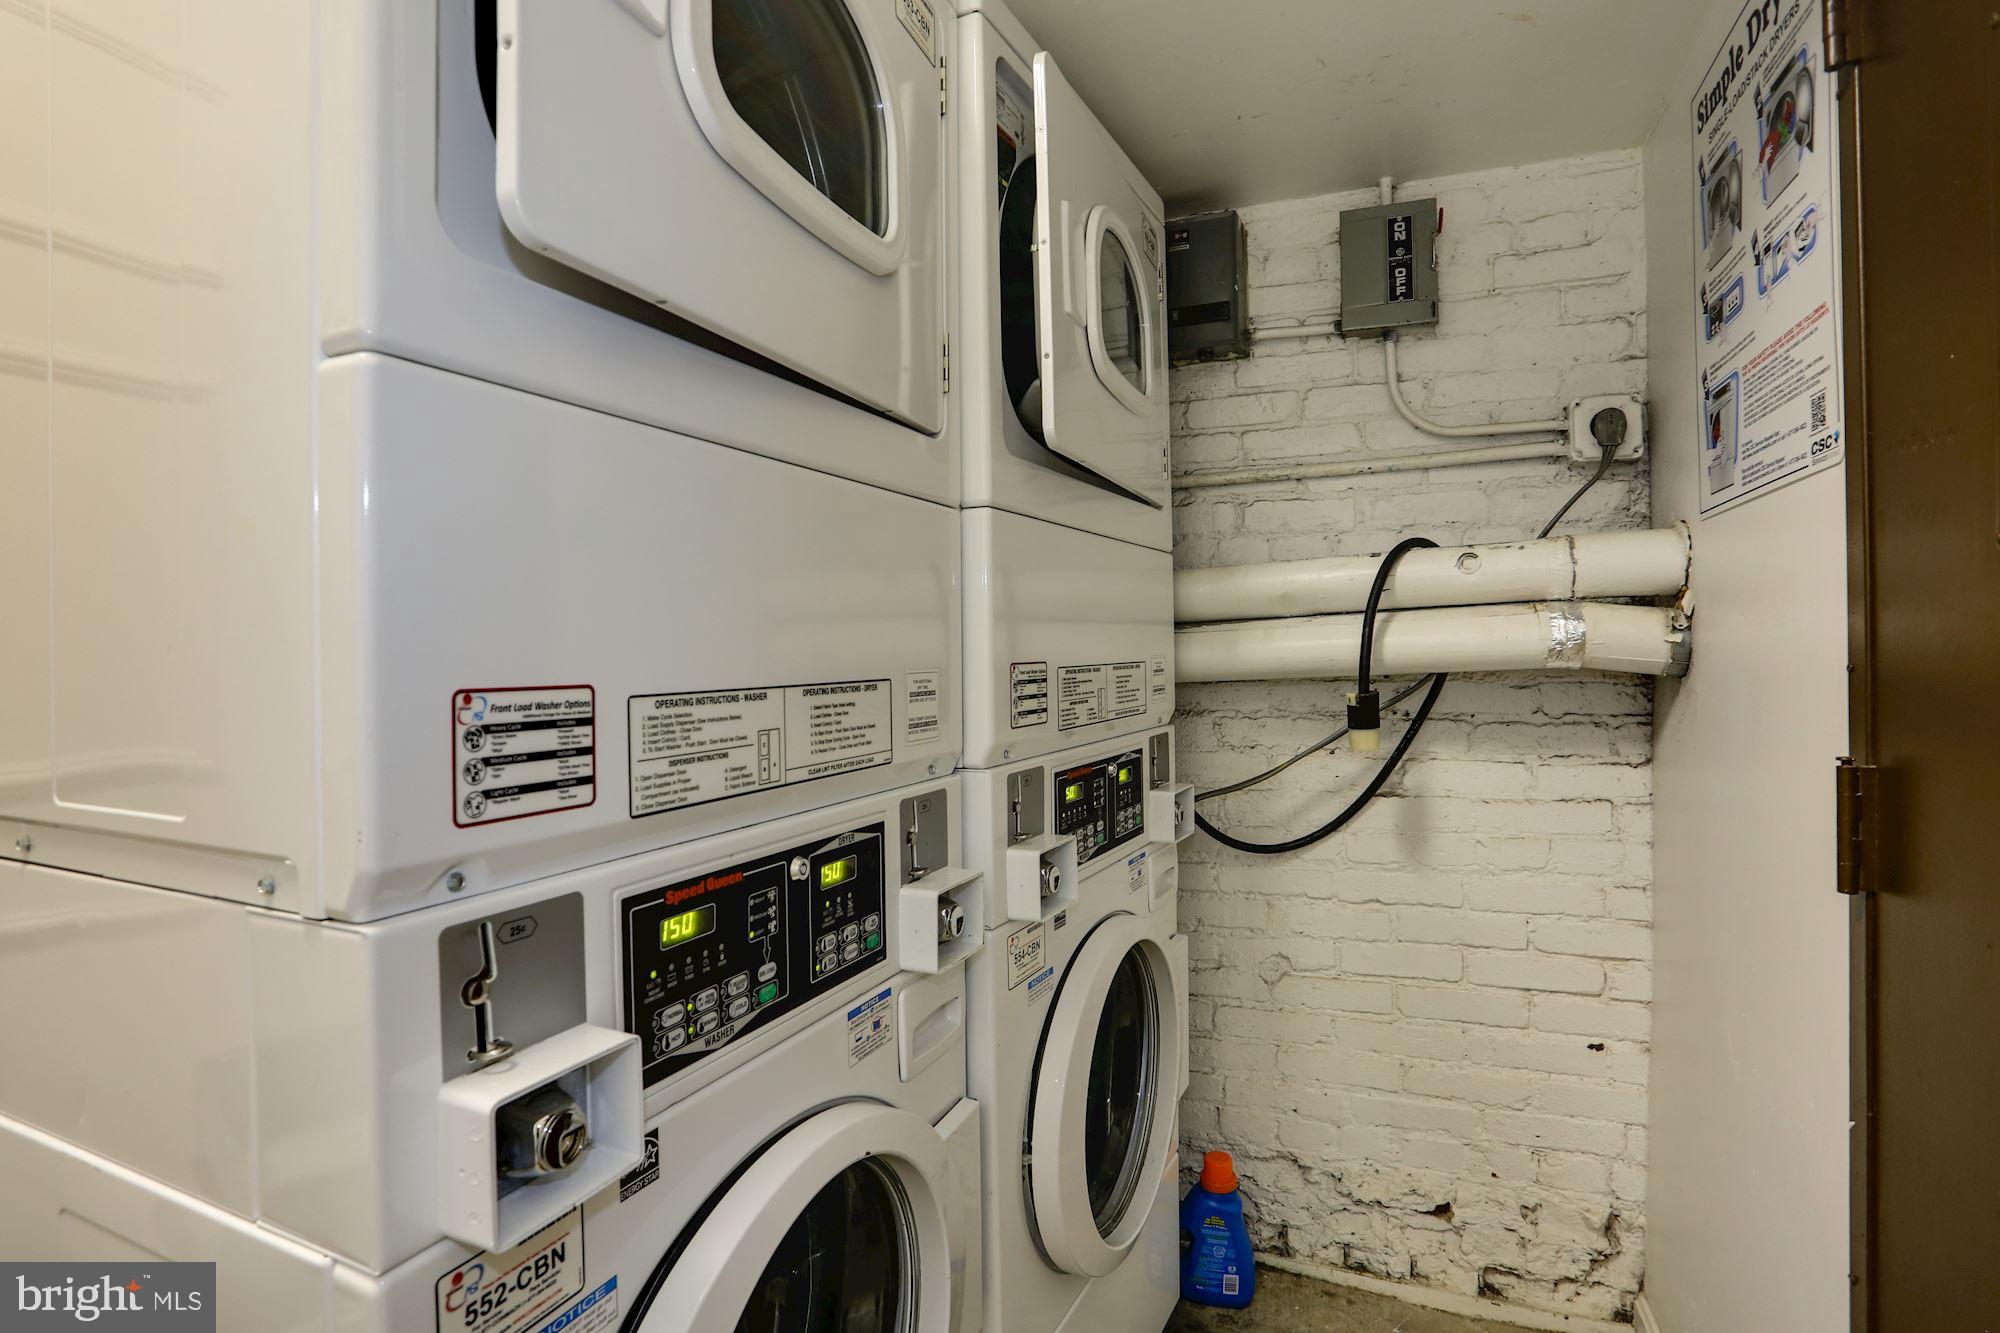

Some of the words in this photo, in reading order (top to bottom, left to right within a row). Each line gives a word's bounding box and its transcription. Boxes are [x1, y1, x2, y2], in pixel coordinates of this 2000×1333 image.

[1698, 45, 1744, 134] Simple
[1394, 222, 1406, 241] ON
[1395, 268, 1407, 296] OFF
[1811, 435, 1832, 455] CSC
[655, 698, 694, 709] OPERATING
[695, 694, 740, 706] INSTRUCTIONS
[744, 692, 768, 702] WASHER
[802, 687, 830, 697] OPERATING
[830, 684, 861, 694] INSTRUCTIONS
[864, 683, 878, 692] DRYER
[490, 704, 512, 713] Front
[513, 702, 532, 712] Load
[535, 701, 562, 711] Washer
[564, 699, 591, 710] Options
[668, 756, 696, 768] DISPENSER
[697, 752, 729, 763] INSTRUCTIONS
[808, 767, 821, 776] CLEAN
[821, 766, 830, 774] LINT
[831, 764, 843, 772] FILTER
[843, 761, 854, 769] AFTER
[855, 759, 864, 767] EACH
[865, 757, 874, 765] LOAD
[838, 833, 855, 846] DRYER
[821, 861, 843, 883] 150
[666, 881, 704, 905] Speed
[707, 871, 743, 890] Queen
[662, 911, 696, 943] 150
[1014, 939, 1041, 965] 554-CBN
[671, 1032, 681, 1042] HOT
[705, 1024, 736, 1048] WASHER
[620, 1180, 643, 1201] ENERGY
[644, 1171, 659, 1187] STAR
[465, 1242, 566, 1326] 552-CBN
